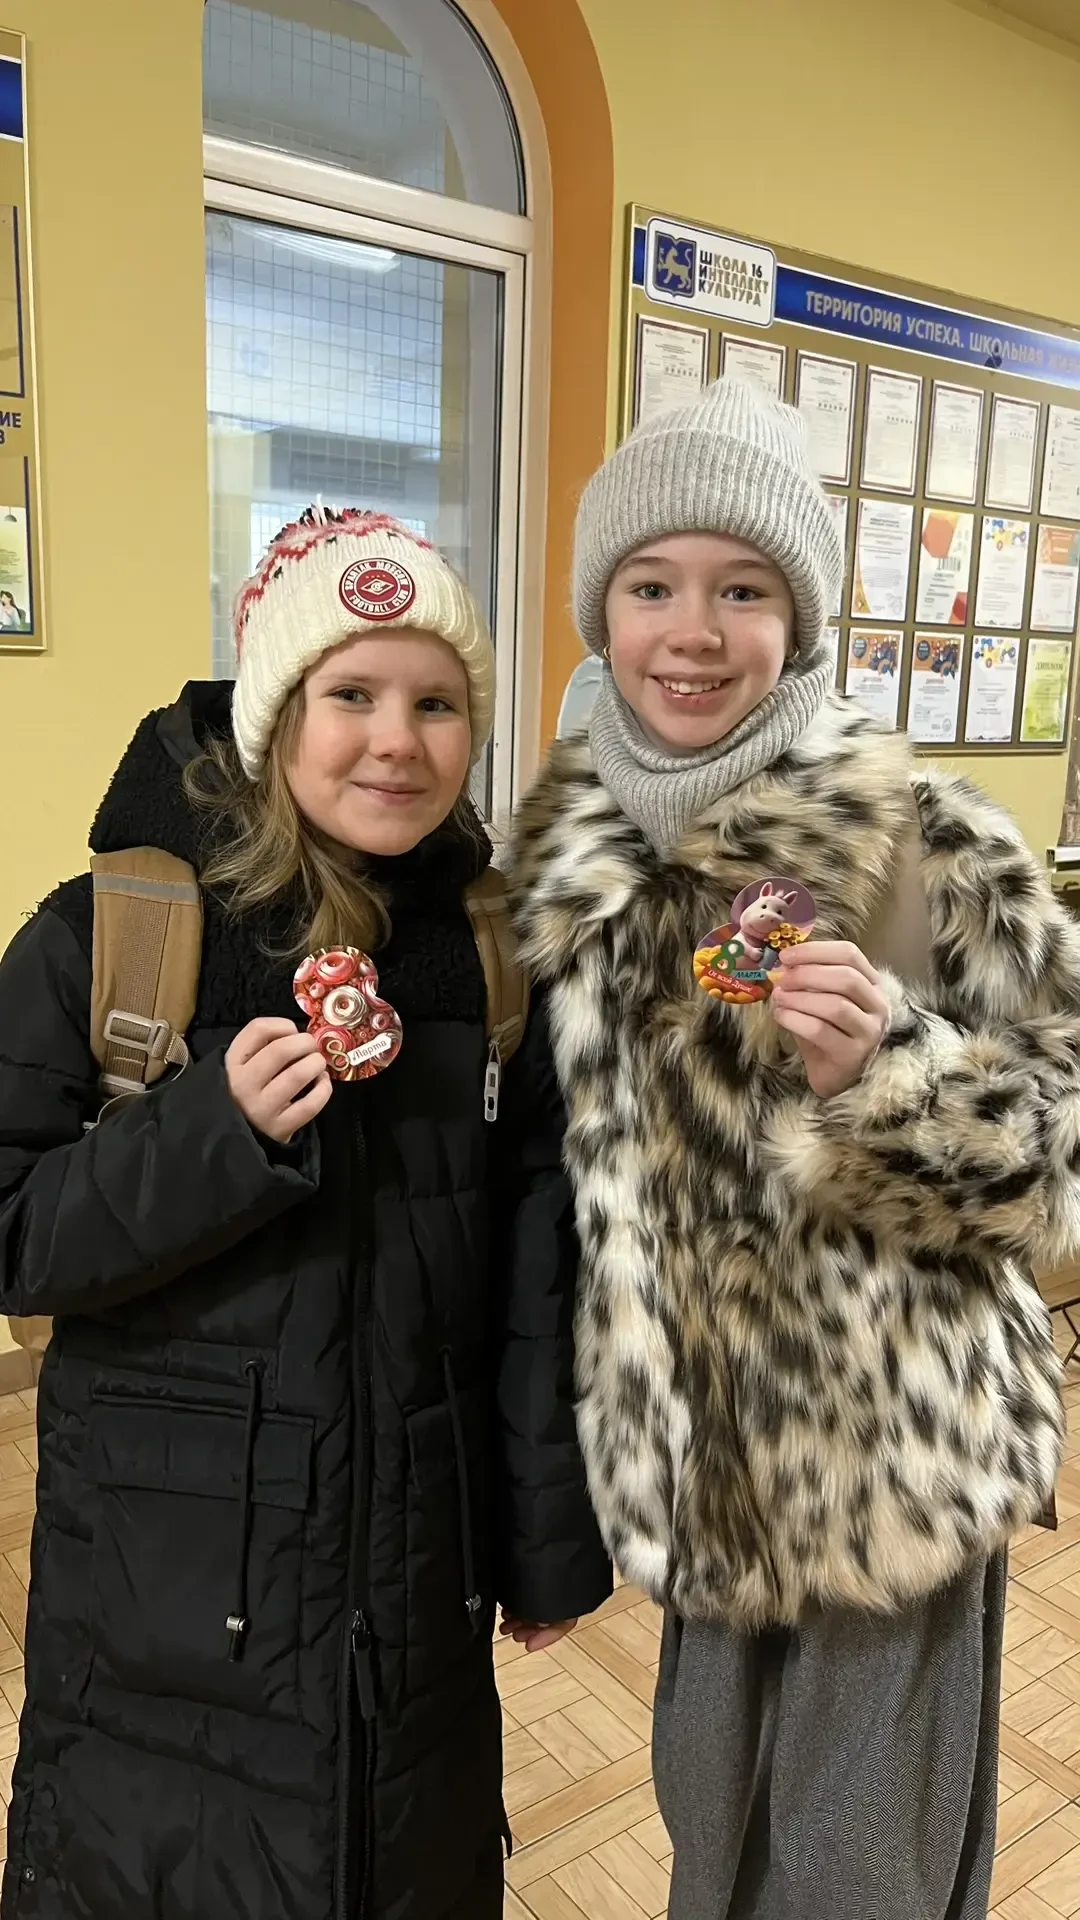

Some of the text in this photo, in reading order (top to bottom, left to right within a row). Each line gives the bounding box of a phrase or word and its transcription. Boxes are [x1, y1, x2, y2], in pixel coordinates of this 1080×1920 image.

[700, 250, 763, 278] ШКОЛА 16
[699, 265, 769, 294] ИНТЕЛЛЕКТ
[699, 280, 761, 306] КУЛЬТУРА
[806, 290, 902, 334] ТЕРРИТОРИЯ
[905, 315, 965, 349] УСПЕХА.
[969, 331, 1044, 364] ШКОЛЬНАЯ
[349, 595, 391, 612] FOOTBALL
[735, 971, 762, 979] МАРТА
[326, 1039, 388, 1071] 8 Марта
